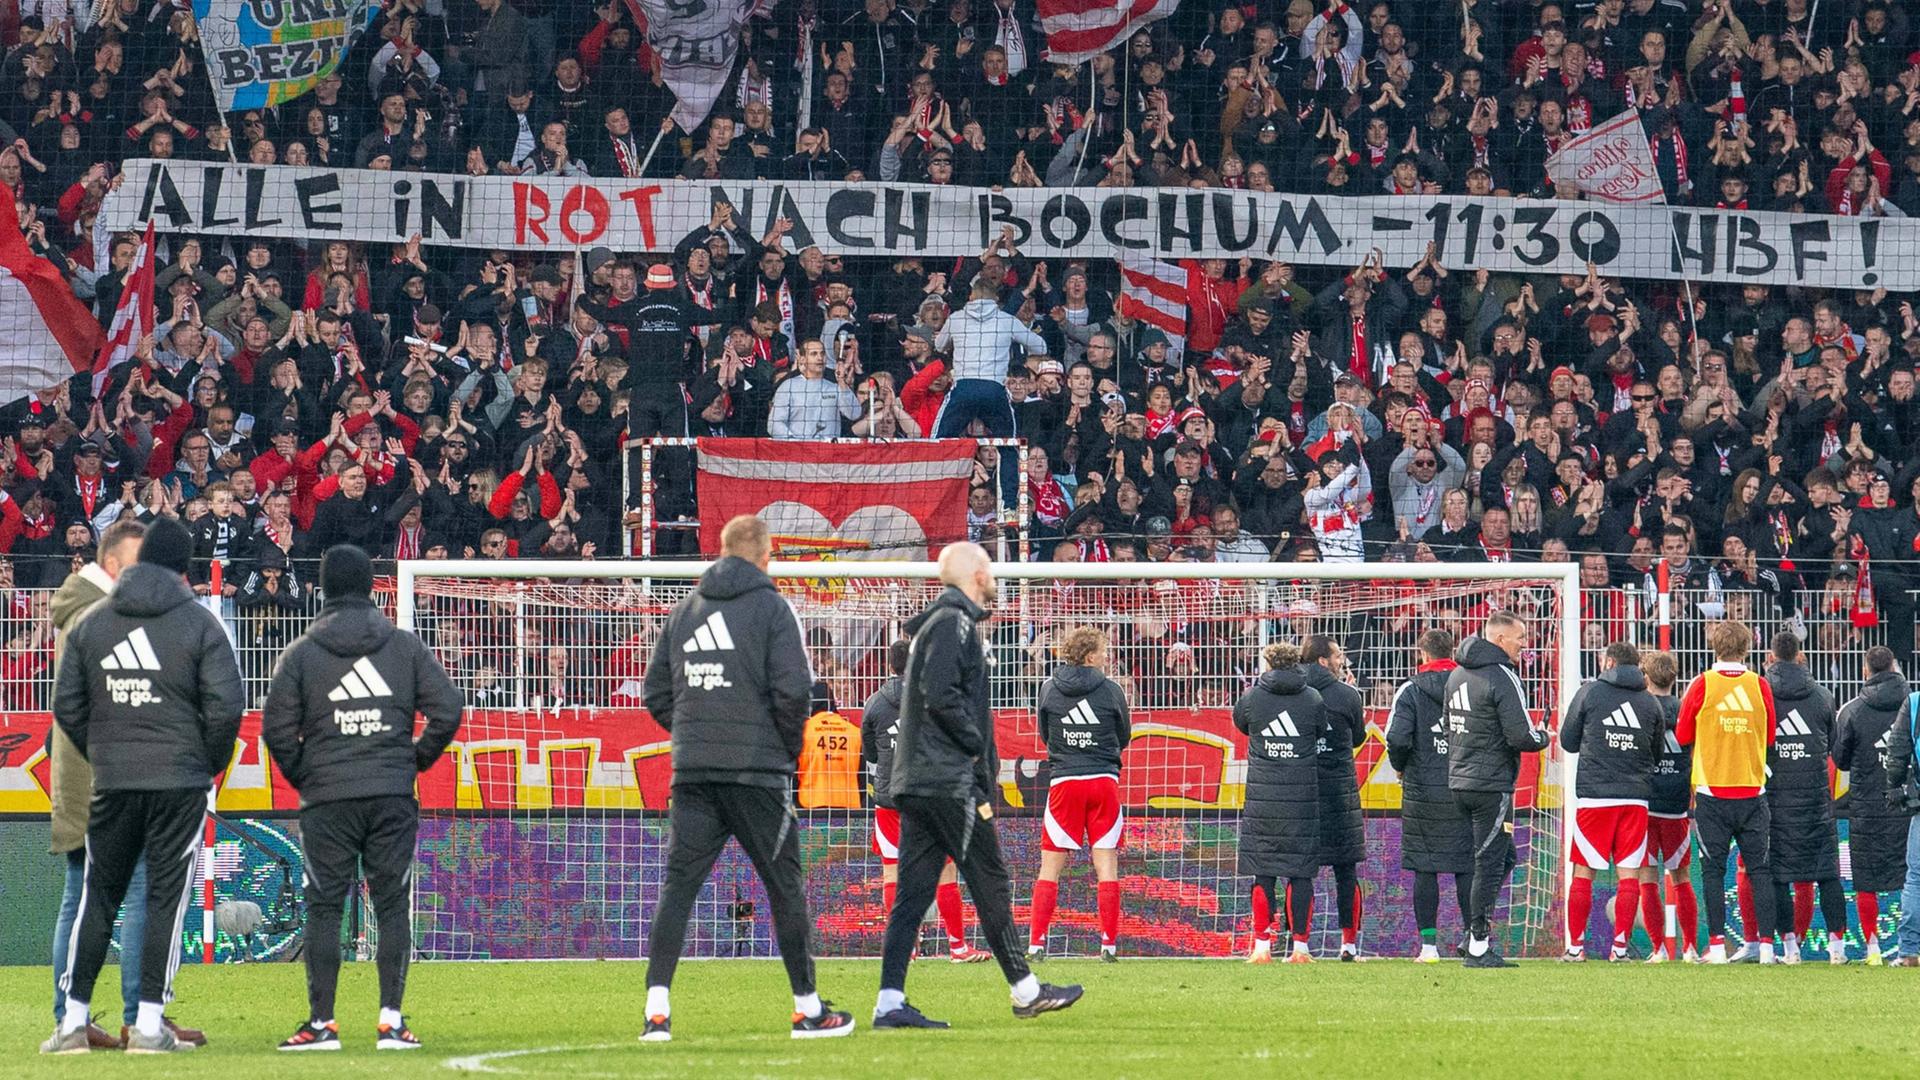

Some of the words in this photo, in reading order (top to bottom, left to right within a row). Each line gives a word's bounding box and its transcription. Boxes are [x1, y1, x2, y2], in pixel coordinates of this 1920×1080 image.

[217, 37, 344, 86] BEZI
[138, 163, 343, 231] ALLE
[513, 182, 662, 251] ROT
[710, 185, 931, 251] NACH
[978, 193, 1342, 256] BOCHUM
[684, 660, 724, 676] home
[106, 674, 152, 691] home
[688, 673, 703, 688] to
[112, 689, 129, 704] to
[334, 708, 382, 724] home
[1719, 714, 1748, 725] home
[341, 720, 359, 735] to
[1063, 728, 1092, 739] home
[1605, 730, 1634, 741] home
[816, 735, 848, 751] 452
[1067, 738, 1078, 746] to
[1264, 739, 1294, 750] home
[1433, 736, 1449, 747] ho
[1608, 739, 1620, 748] to
[1775, 741, 1805, 751] home
[1268, 749, 1279, 757] to
[1779, 749, 1790, 758] to
